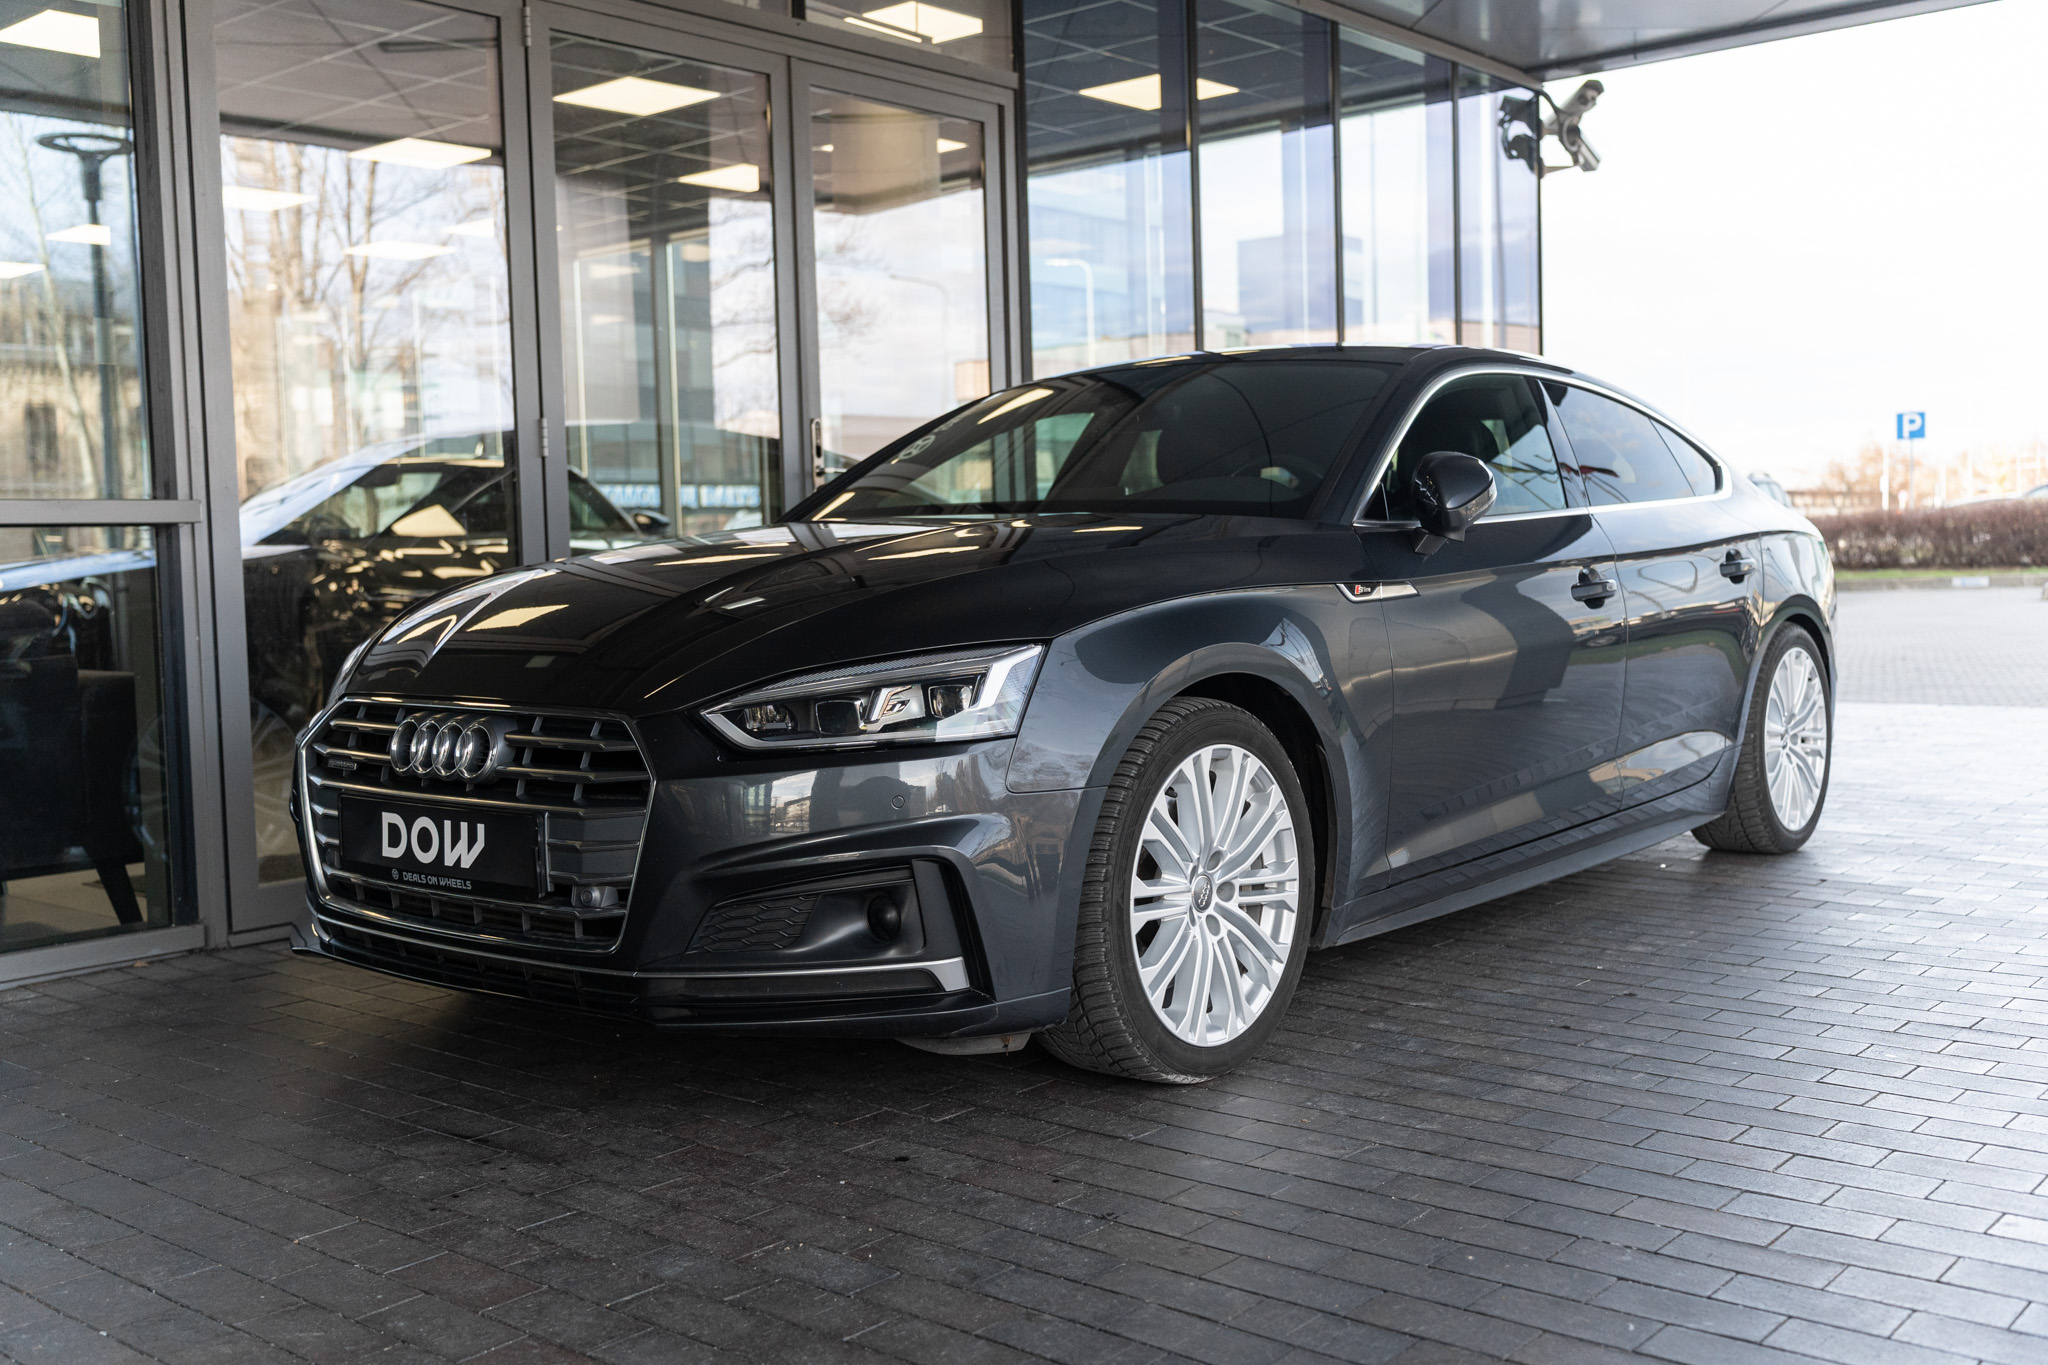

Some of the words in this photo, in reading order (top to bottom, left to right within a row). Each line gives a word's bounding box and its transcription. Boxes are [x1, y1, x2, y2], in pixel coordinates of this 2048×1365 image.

[1902, 413, 1922, 439] P
[381, 811, 485, 869] DOW
[402, 872, 427, 884] DEALS
[427, 875, 438, 886] ON
[439, 876, 472, 890] WHEELS
